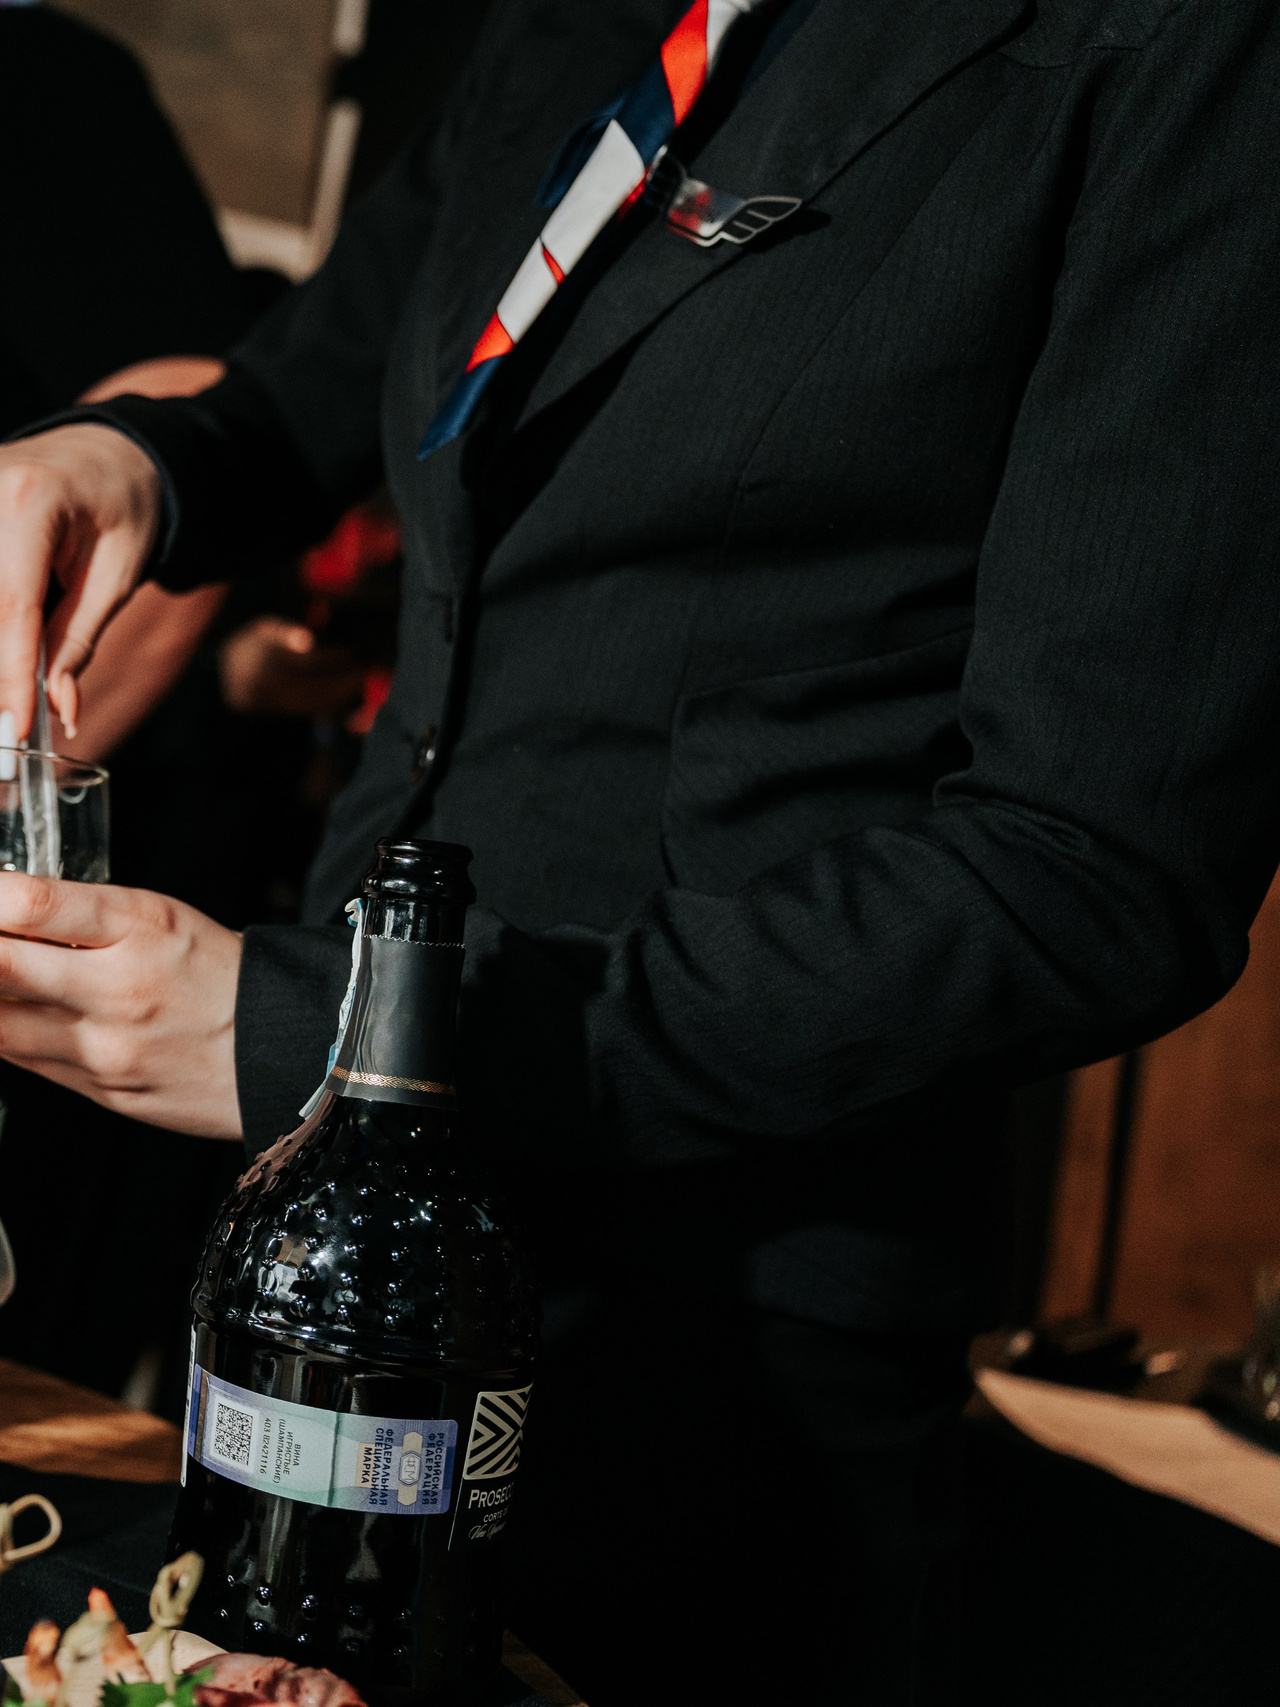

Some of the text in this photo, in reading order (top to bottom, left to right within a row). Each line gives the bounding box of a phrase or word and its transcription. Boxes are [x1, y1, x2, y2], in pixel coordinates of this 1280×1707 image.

[259, 1434, 271, 1475] 82421116
[272, 1418, 286, 1484] (ШАМПАНСКИЕ)
[283, 1431, 293, 1475] ИГРИСТЫЕ
[292, 1443, 301, 1467] ВИНА
[361, 1447, 373, 1484] МАРКА
[369, 1427, 384, 1505] СПЕЦИАЛЬНАЯ
[379, 1429, 394, 1506] ФЕДЕРАЛЬНАЯ
[422, 1433, 436, 1505] ФЕДЕРАЦИЯ
[430, 1433, 445, 1505] РОССИЙСКАЯ
[467, 1482, 514, 1509] PROSECC
[483, 1510, 504, 1523] CORTE
